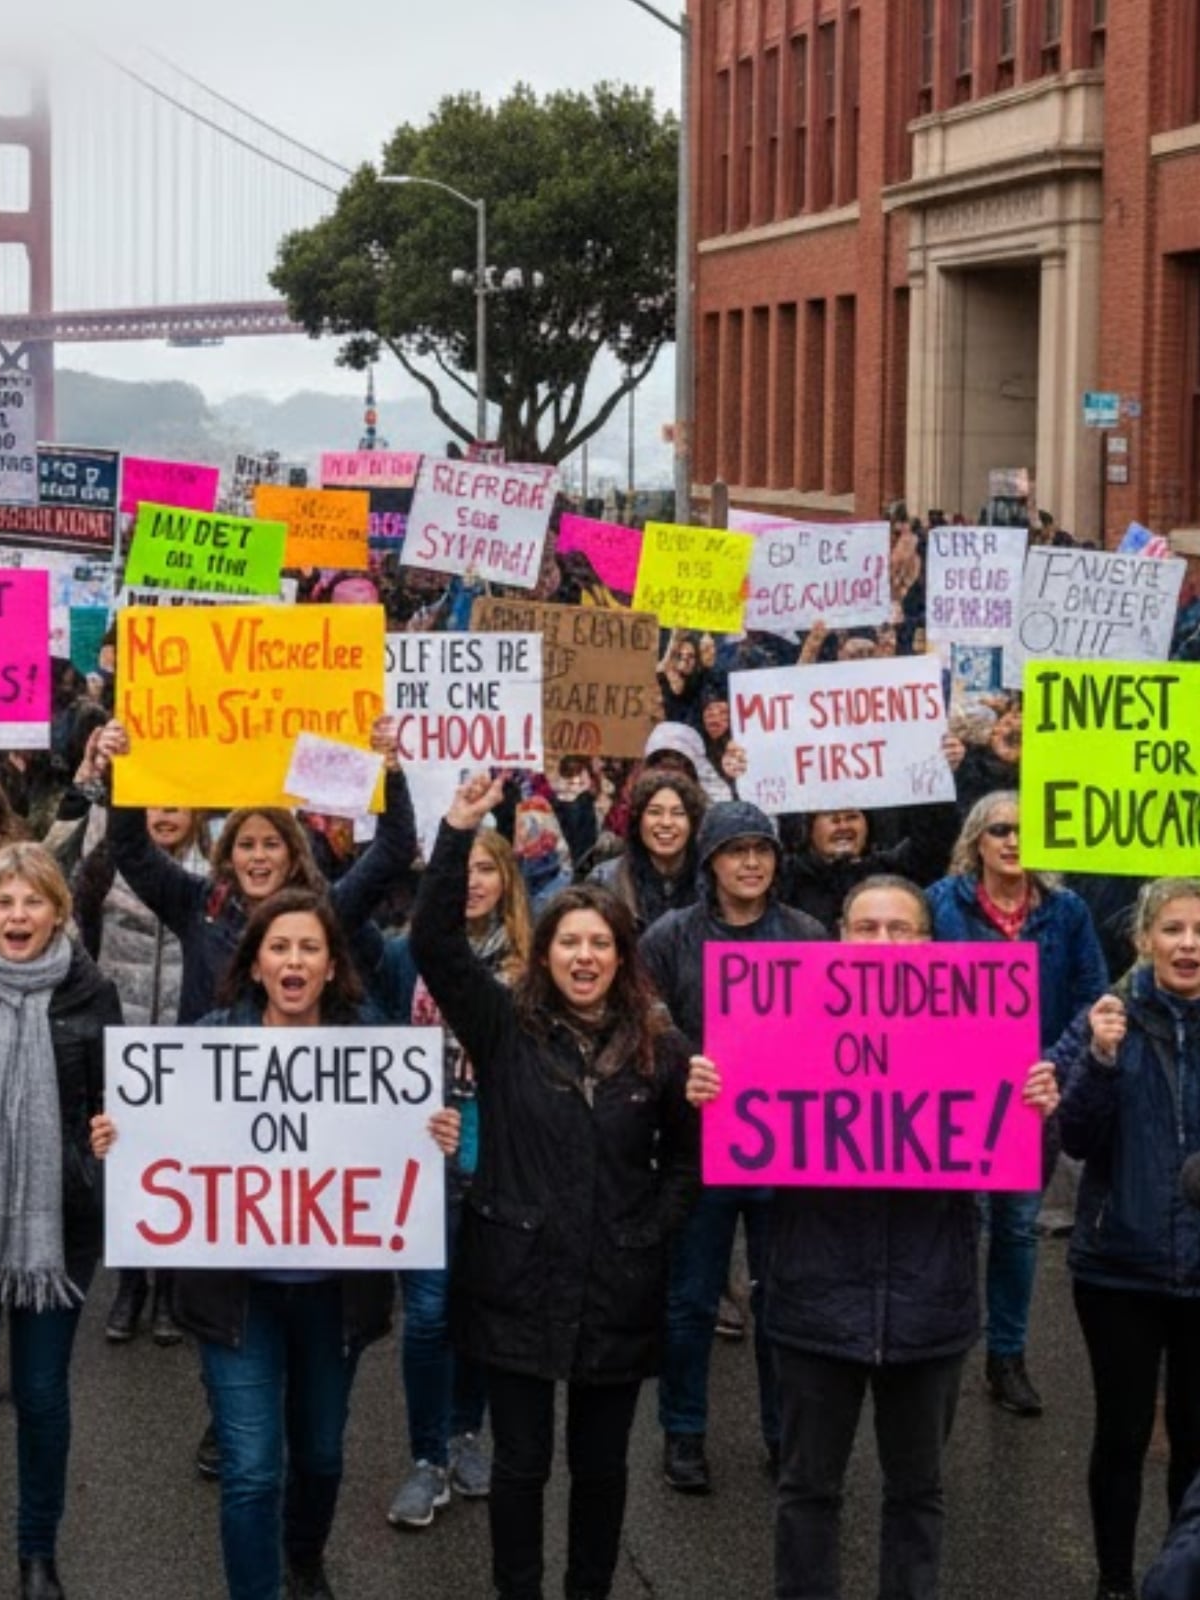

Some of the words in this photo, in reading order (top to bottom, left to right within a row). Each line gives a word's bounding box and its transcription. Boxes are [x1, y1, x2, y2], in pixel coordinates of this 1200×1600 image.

[1036, 671, 1180, 733] INVEST
[795, 740, 887, 786] FIRST
[1133, 740, 1198, 776] FOR
[1043, 780, 1200, 850] EDUCAT
[718, 953, 803, 1017] PUT
[823, 959, 1032, 1019] STUDENTS
[116, 1042, 184, 1107] SF
[200, 1043, 433, 1106] TEACHERS
[833, 1031, 889, 1078] ON
[251, 1111, 308, 1154] ON
[727, 1078, 1015, 1177] STRIKE!
[135, 1157, 421, 1252] STRIKE!
